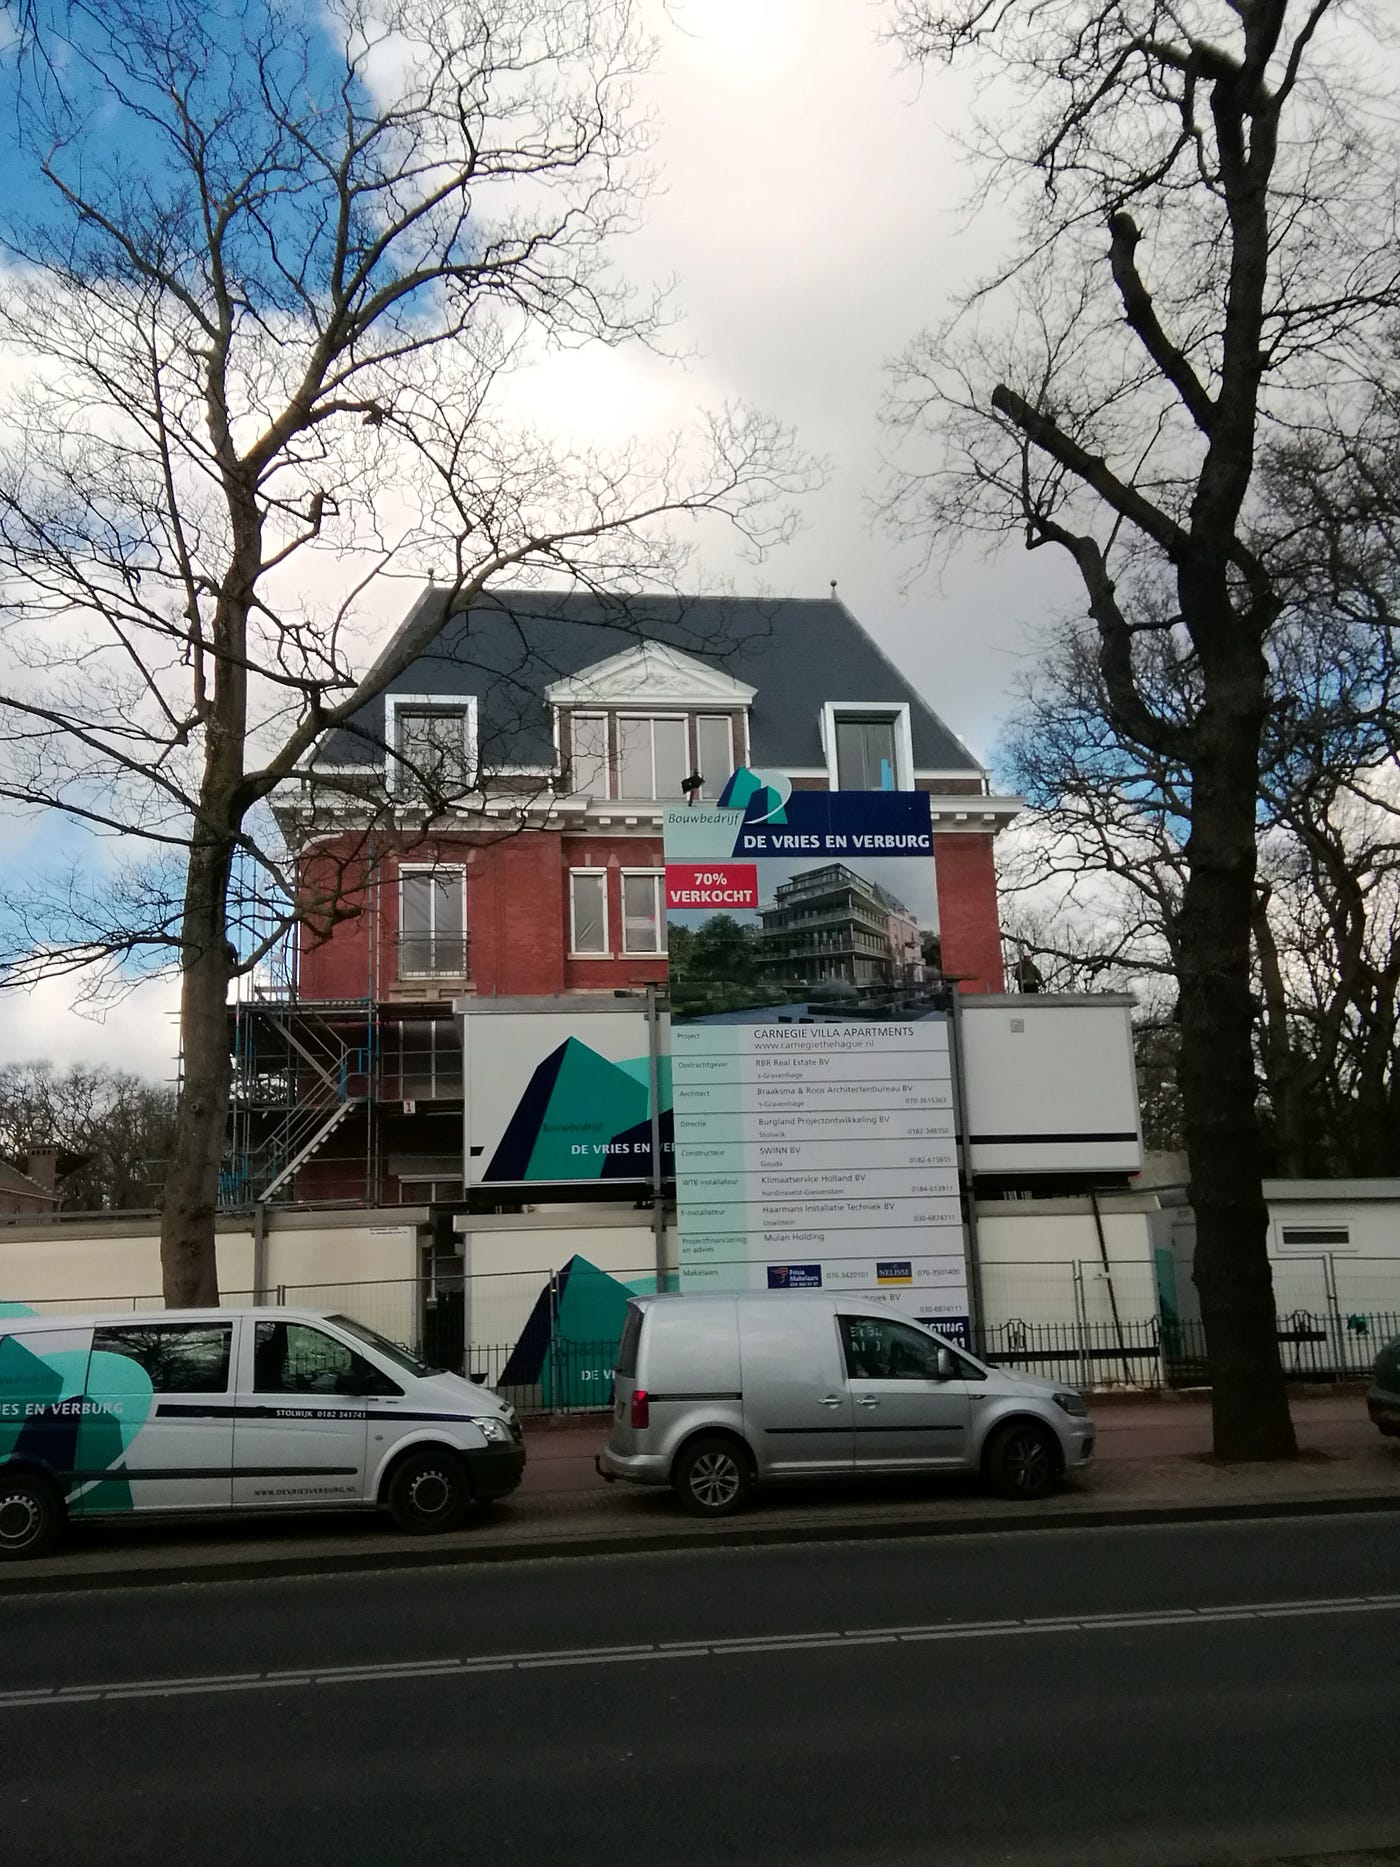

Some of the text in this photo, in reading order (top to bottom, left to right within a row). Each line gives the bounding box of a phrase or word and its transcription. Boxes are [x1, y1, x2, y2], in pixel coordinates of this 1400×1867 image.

[668, 812, 740, 825] Bouwbedrijf
[744, 834, 930, 848] DE VRIES EN VERBURG
[694, 873, 727, 885] 70%
[670, 890, 752, 903] VERKOCHT
[677, 1032, 700, 1040] Project
[754, 1027, 914, 1039] CARNEGIE VILLA APARTMENTS
[754, 1039, 874, 1050] www.carnegiethehague.nl
[774, 1058, 791, 1066] Real
[793, 1058, 816, 1066] Estate
[405, 1101, 413, 1114] 1
[797, 1116, 877, 1126] Projectontwikkeling
[879, 1115, 890, 1123] BV
[571, 1144, 589, 1155] DE
[593, 1143, 630, 1154] VRIES
[634, 1143, 650, 1153] EN
[789, 1146, 801, 1154] BV
[761, 1174, 866, 1184] Klimaatservice Holland BV
[763, 1203, 895, 1214] Haarmans Installatie Techniek BV
[764, 1232, 825, 1242] Mulan Holding
[581, 1369, 600, 1381] DE
[25, 1403, 45, 1416] EN
[51, 1401, 124, 1416] VERBURG
[275, 1409, 313, 1418] STOLWIJK
[317, 1410, 337, 1418] 0182
